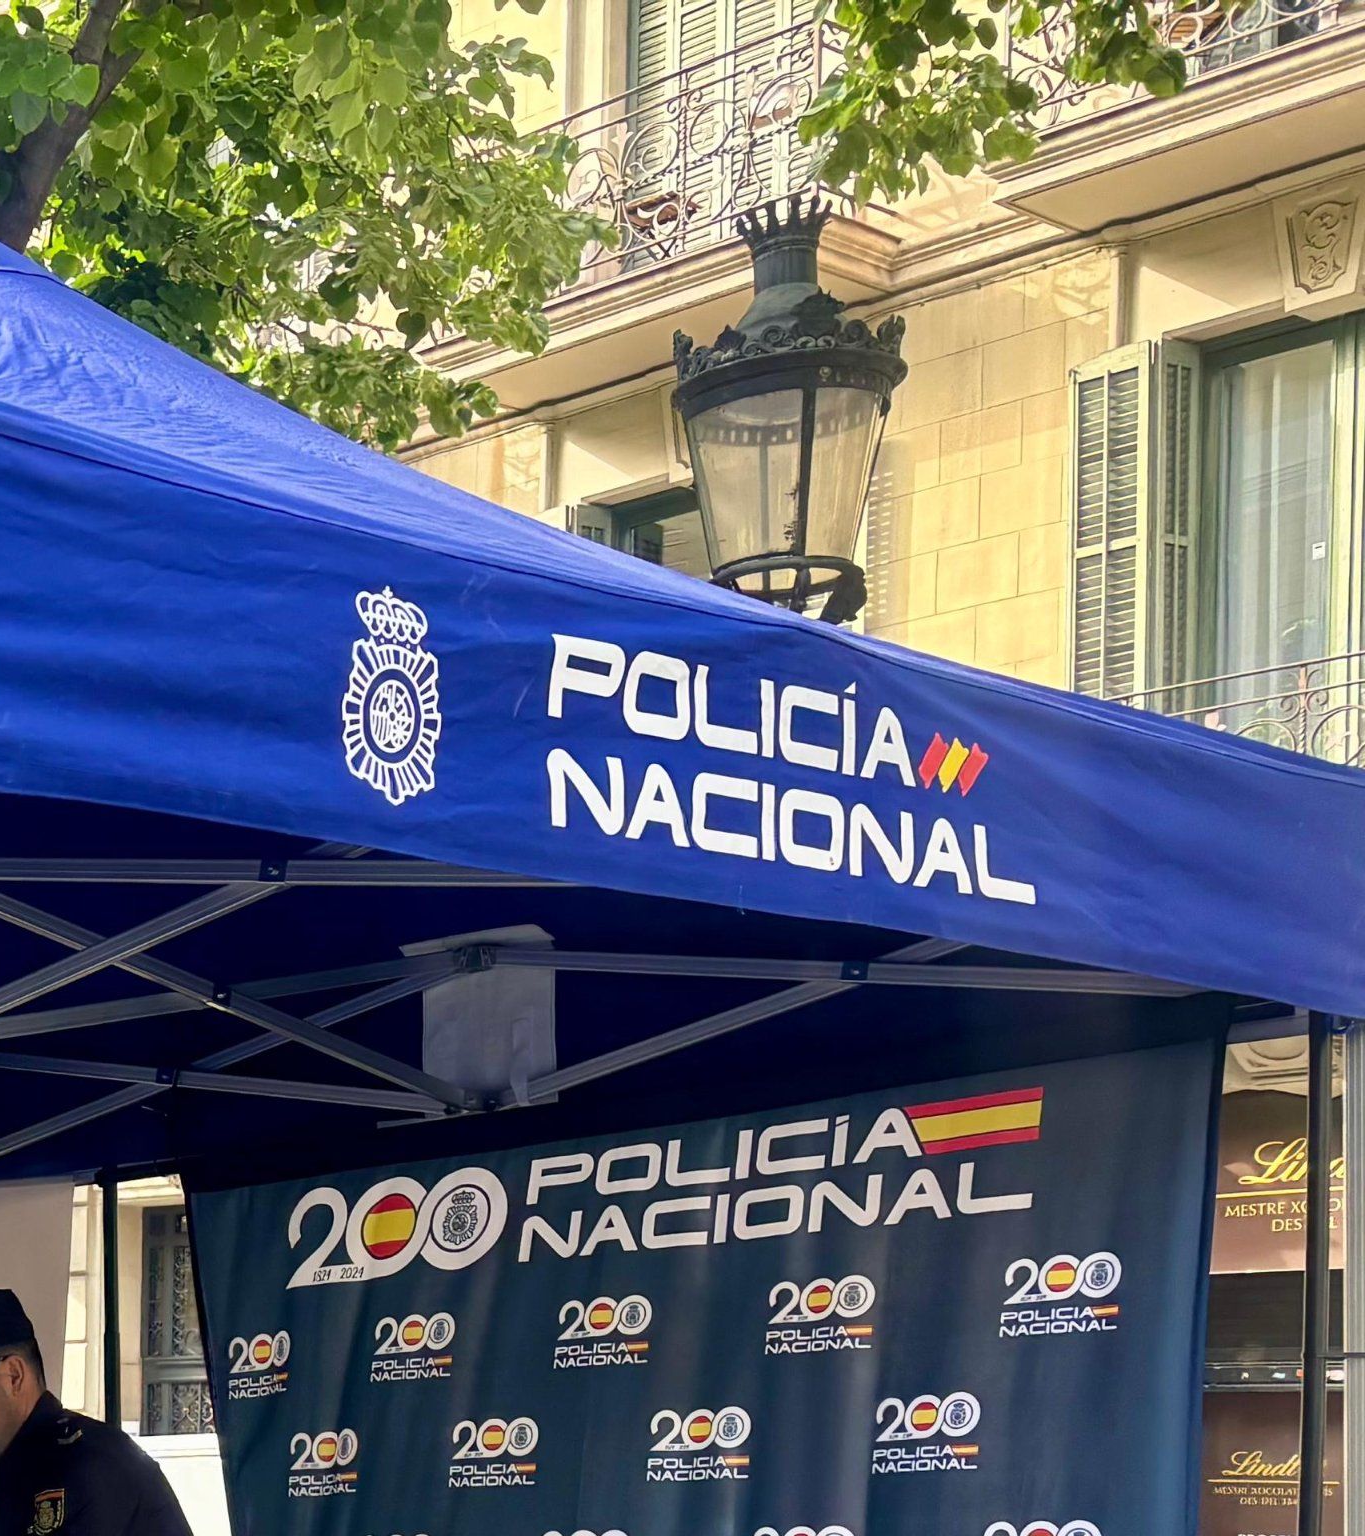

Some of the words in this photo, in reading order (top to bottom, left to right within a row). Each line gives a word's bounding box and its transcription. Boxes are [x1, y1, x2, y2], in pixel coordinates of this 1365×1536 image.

[547, 634, 917, 787] POLICÍA
[549, 749, 1036, 905] NACIONAL
[518, 1162, 1033, 1262] NACIONAL
[1224, 1201, 1286, 1217] MESTRE
[285, 1167, 508, 1290] 200
[1271, 1218, 1303, 1232] DES
[339, 1266, 365, 1280] 2024
[999, 1318, 1118, 1338] NACIONAL
[764, 1337, 871, 1355] NACIONAL
[553, 1353, 648, 1369] NACIONAL
[370, 1366, 451, 1382] NACIONAL
[871, 1457, 978, 1475] NACIONAL
[449, 1473, 536, 1488] NACIONAL
[646, 1467, 749, 1482] NACIONAL
[288, 1481, 356, 1497] NACIONAL
